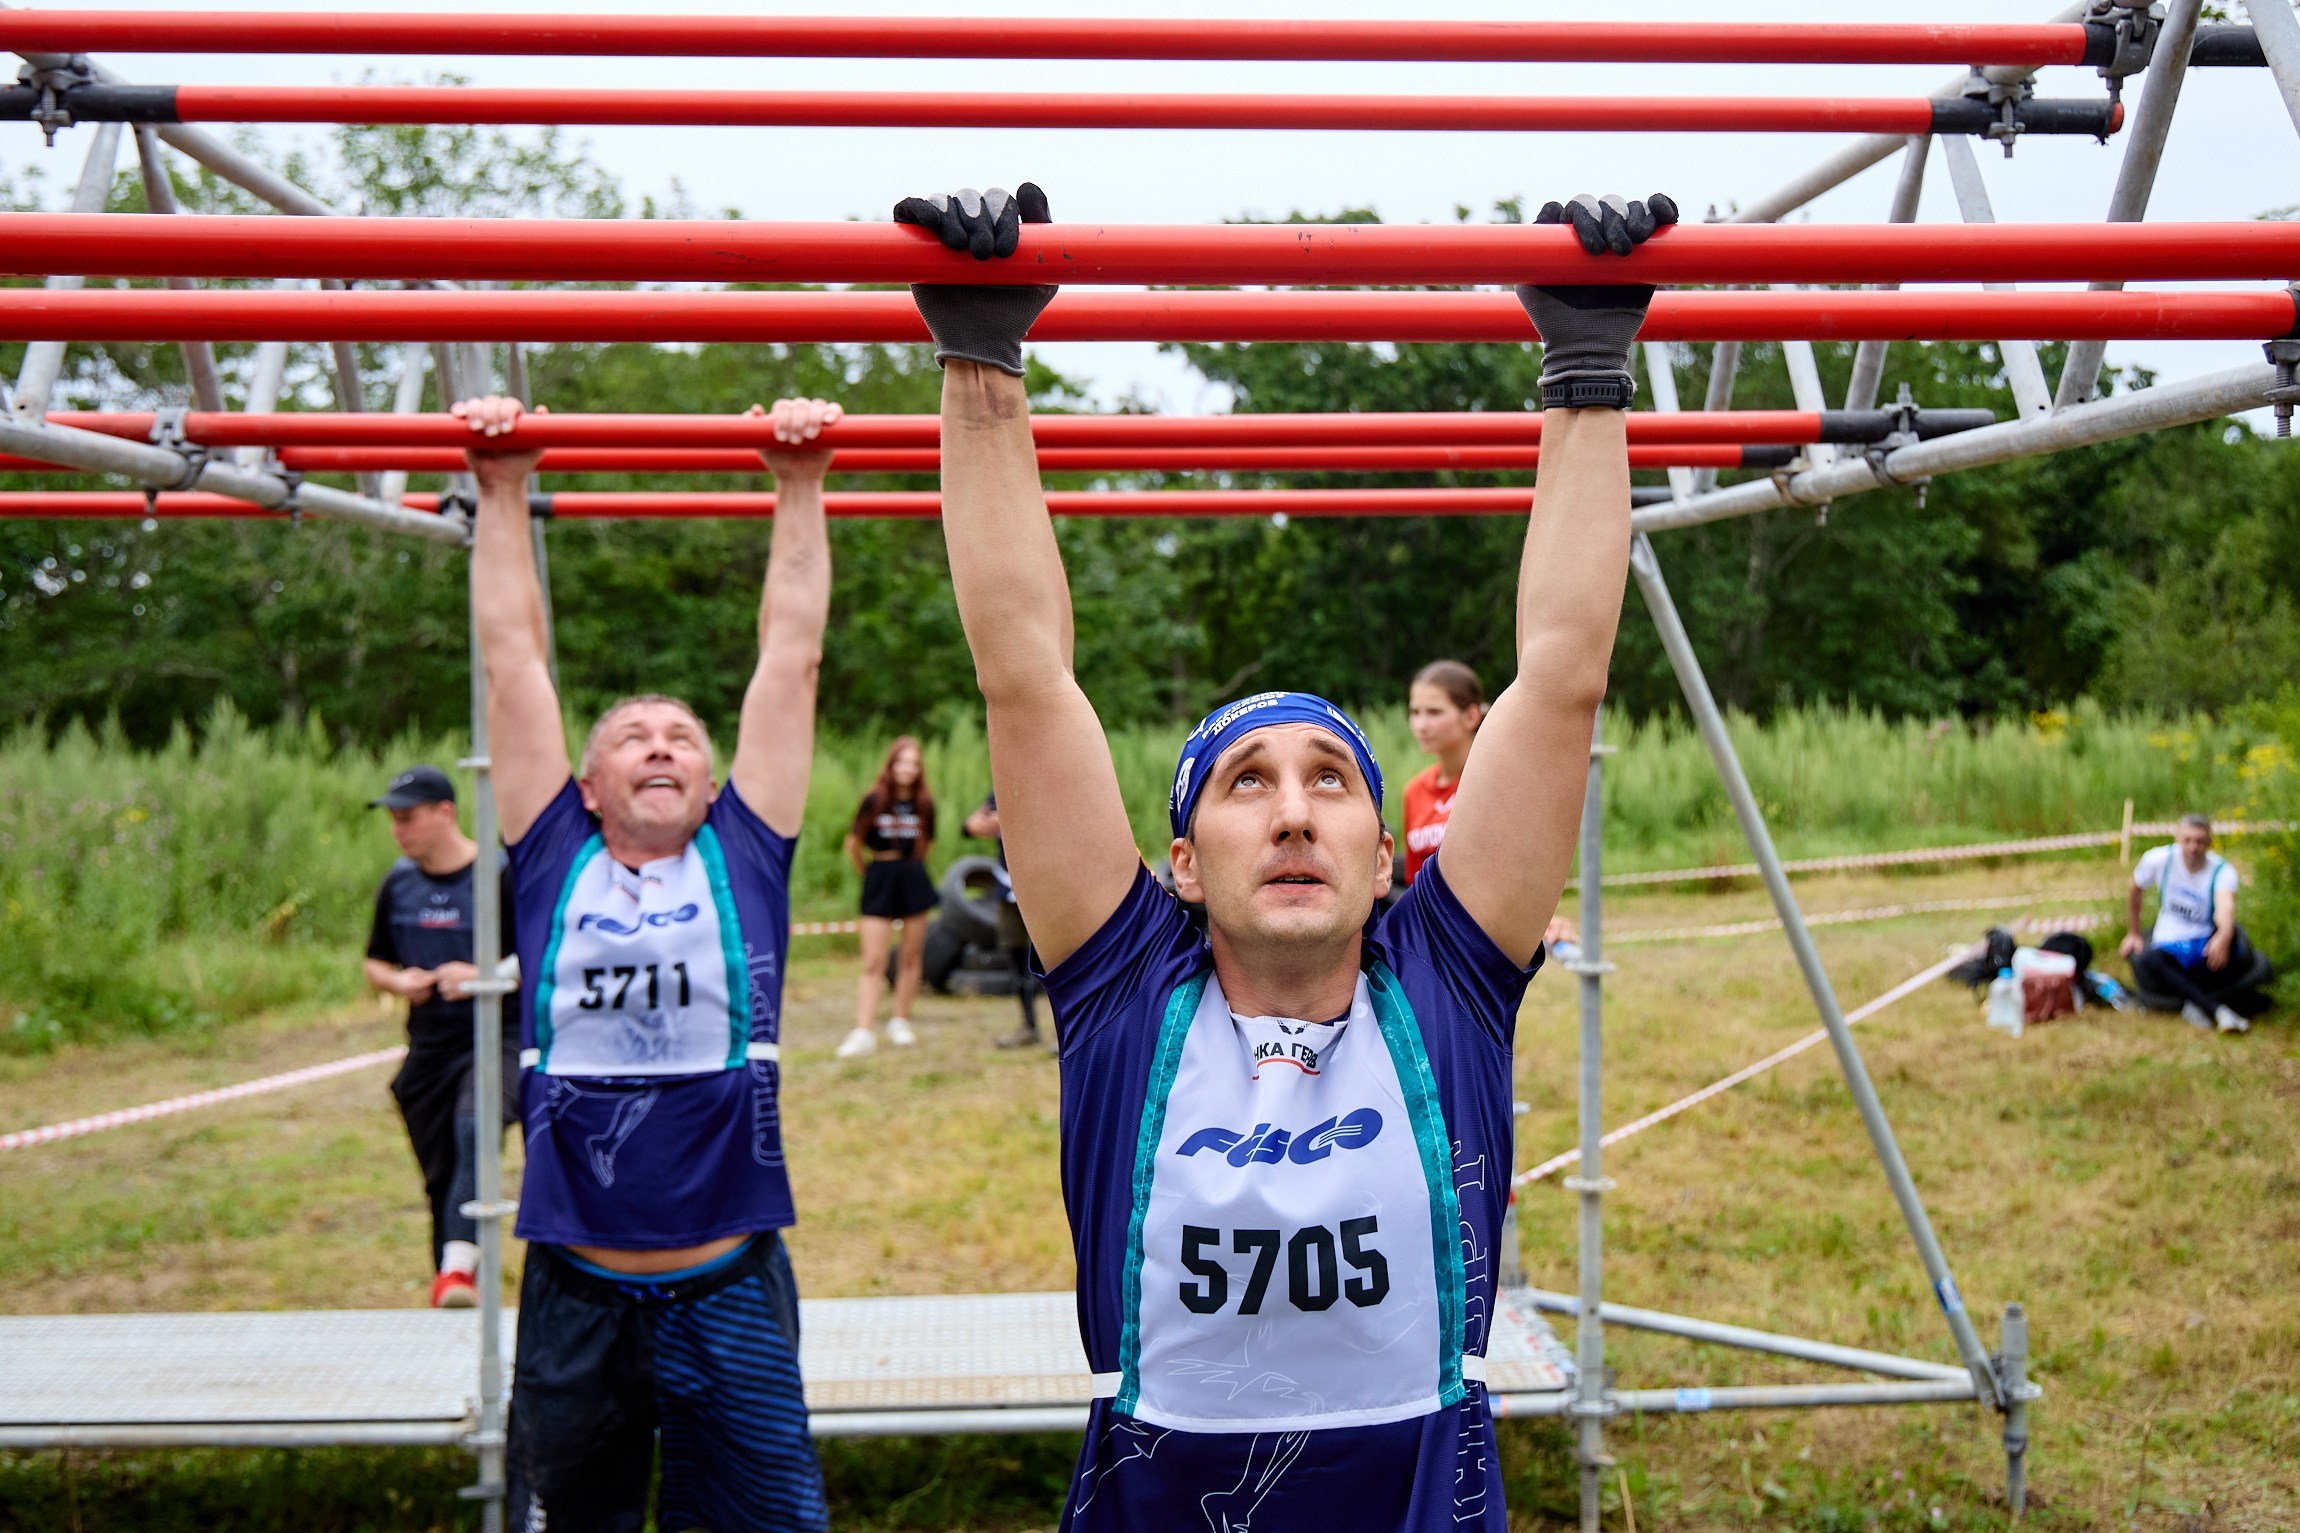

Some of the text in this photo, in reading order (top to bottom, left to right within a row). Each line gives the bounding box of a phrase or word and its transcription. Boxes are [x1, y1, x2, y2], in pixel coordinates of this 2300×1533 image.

[1213, 699, 1279, 736] ДОКЕРОВ
[579, 961, 690, 1010] 5711
[1179, 1215, 1390, 1315] 5705
